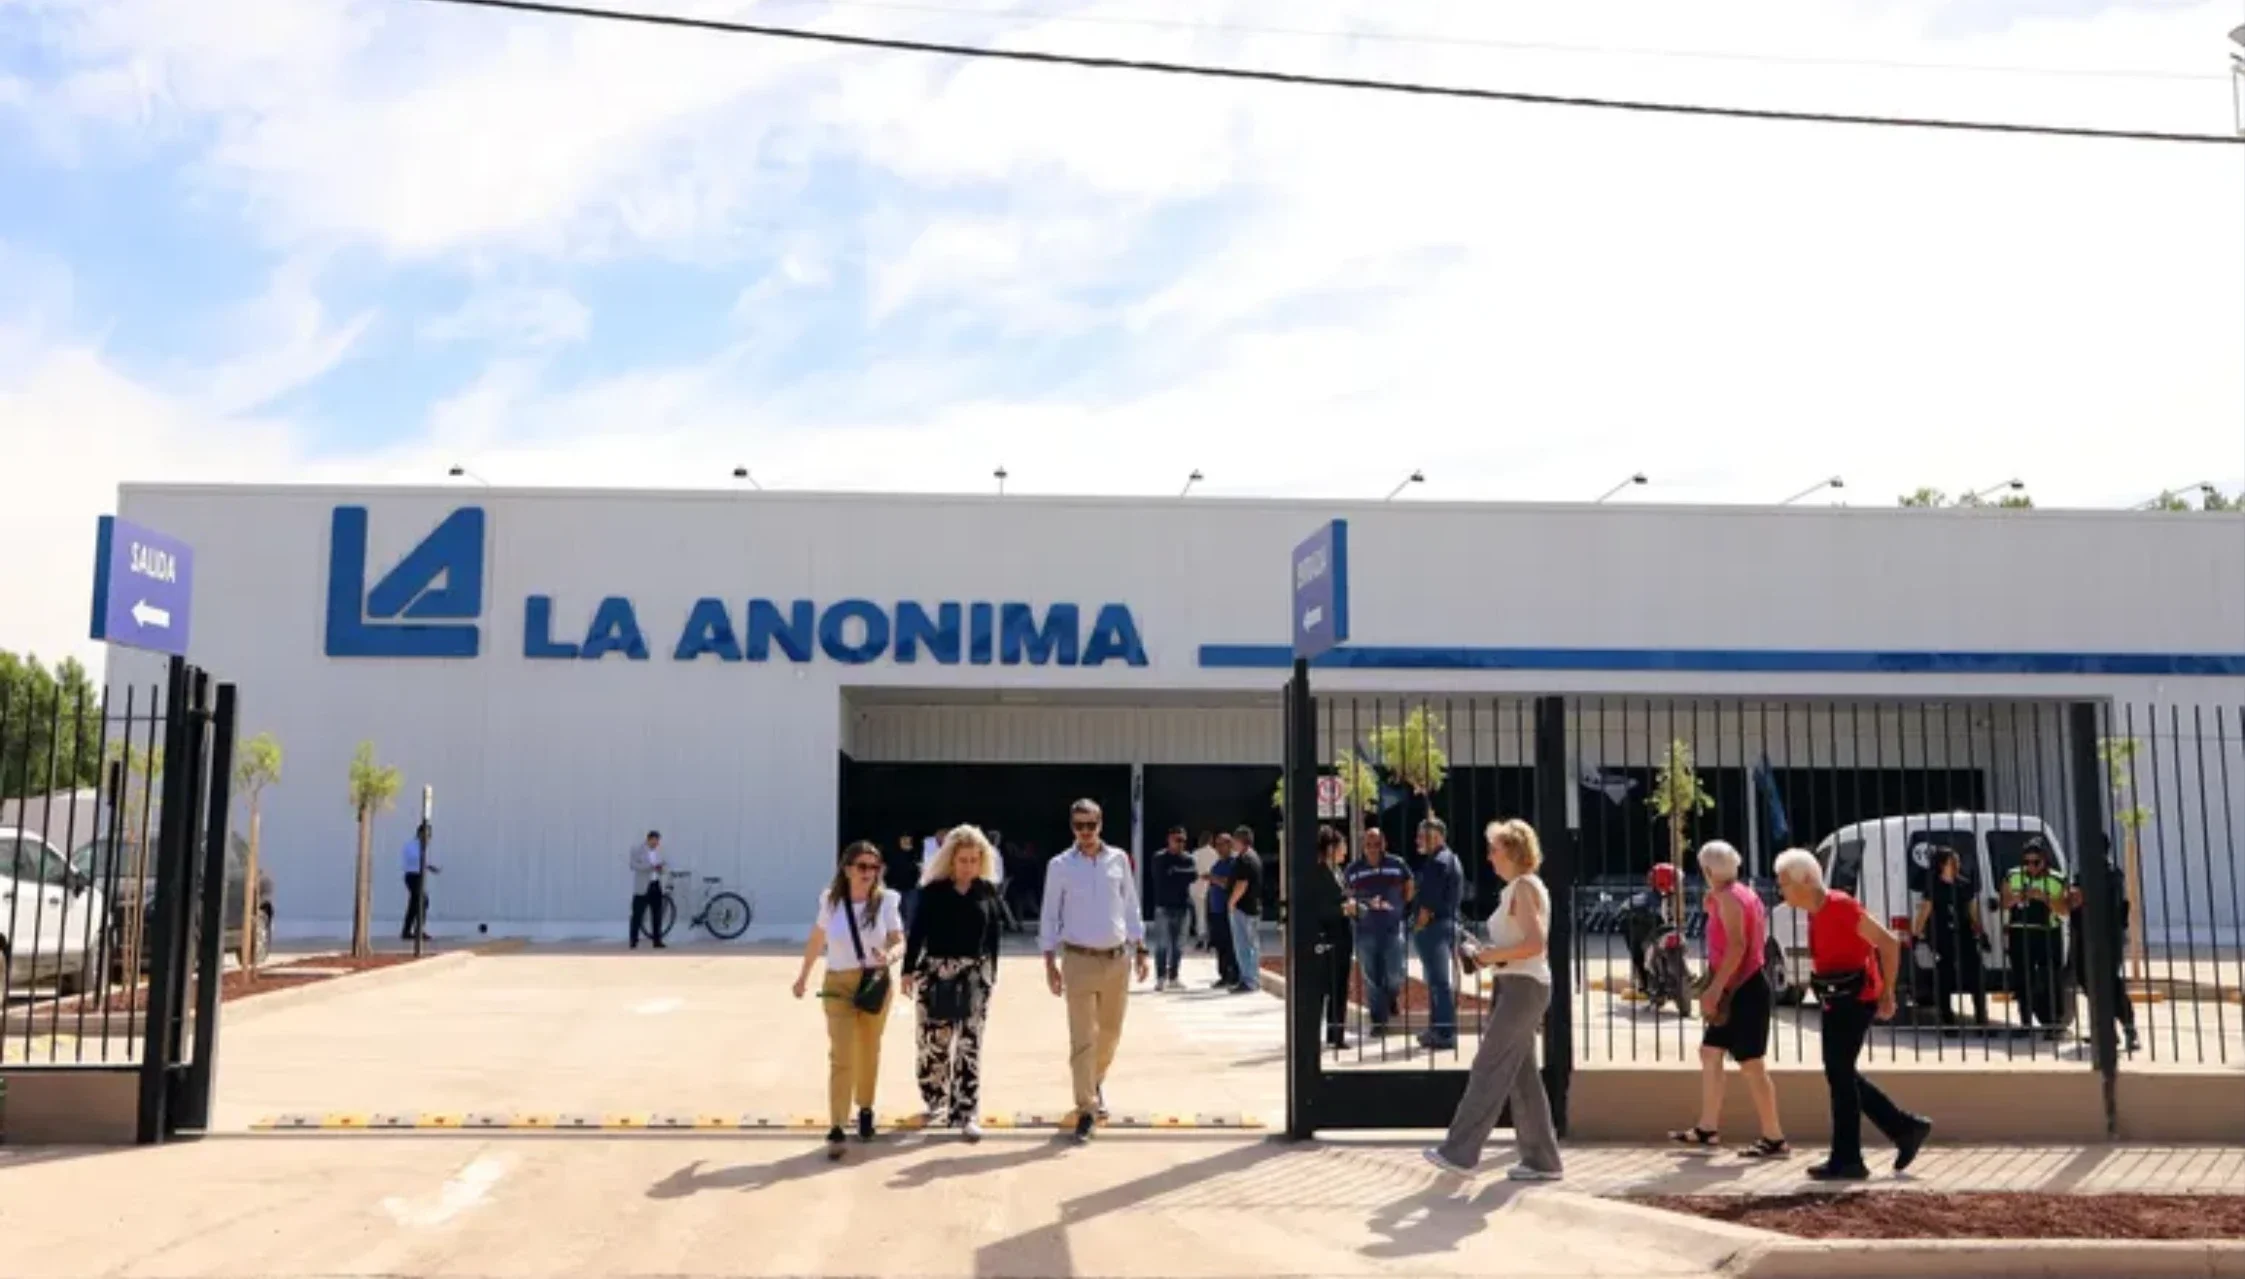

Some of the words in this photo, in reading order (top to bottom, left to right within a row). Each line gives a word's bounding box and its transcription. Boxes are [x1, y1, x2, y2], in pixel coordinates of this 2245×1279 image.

[131, 541, 177, 584] SALIDA
[523, 594, 649, 659] LA
[673, 597, 1149, 666] ANONIMA
